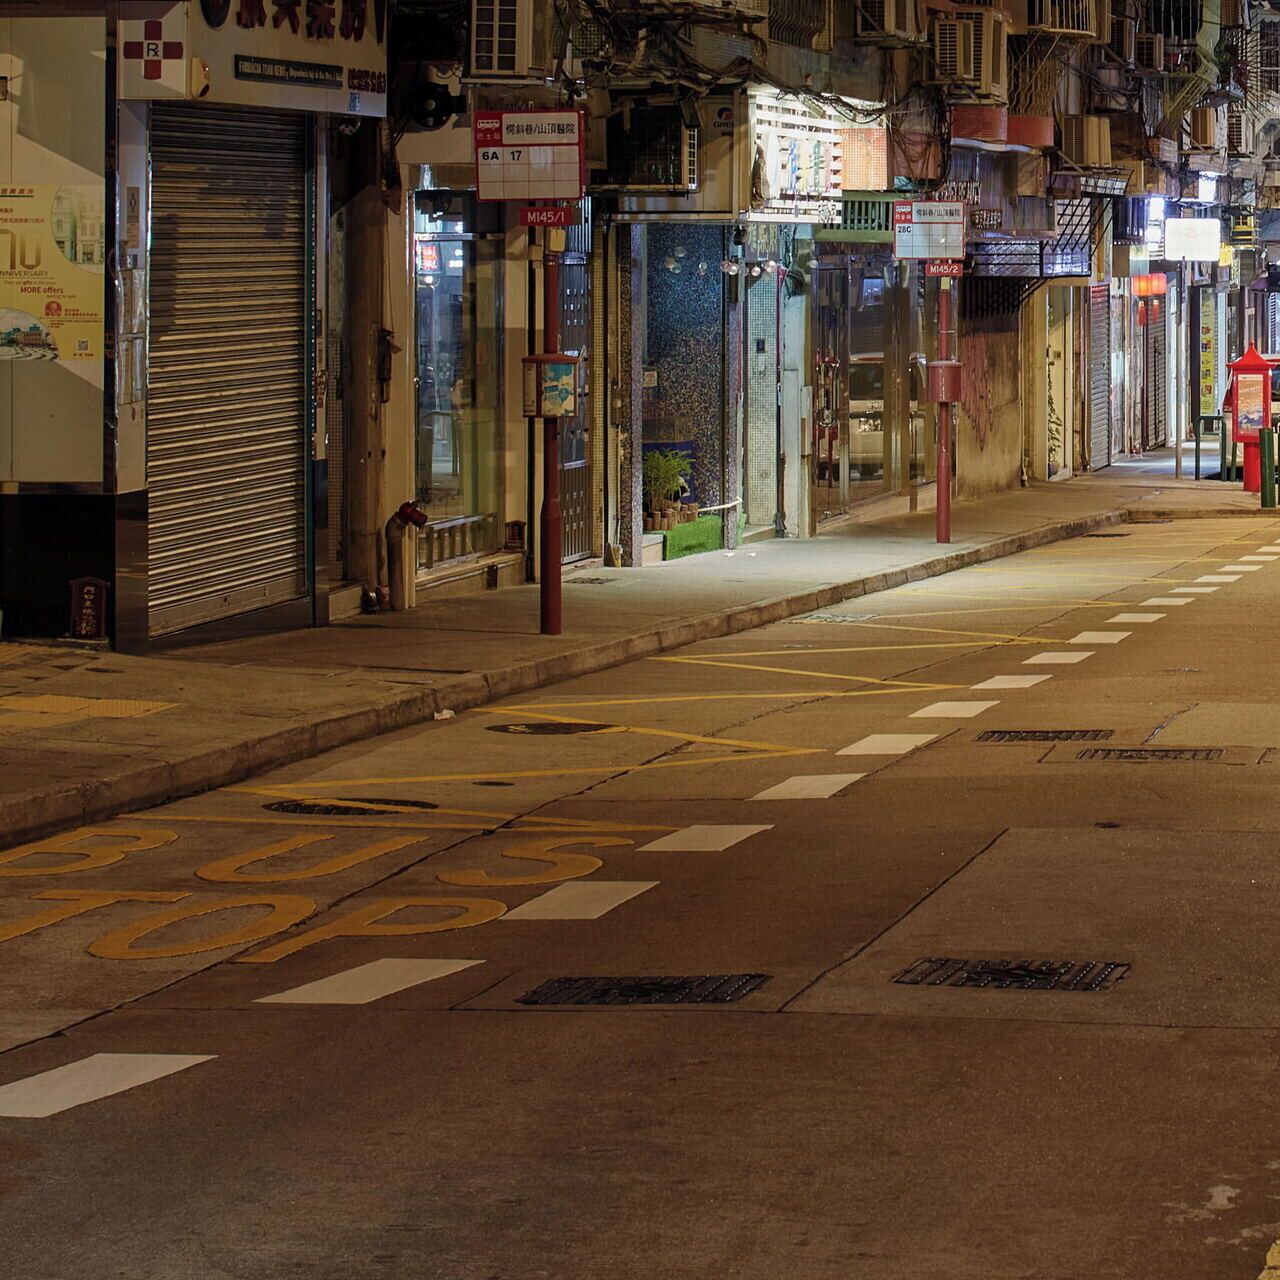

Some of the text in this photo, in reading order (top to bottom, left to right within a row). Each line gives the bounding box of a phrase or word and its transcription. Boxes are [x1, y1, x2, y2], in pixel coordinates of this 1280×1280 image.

[482, 150, 522, 161] 6A 17
[527, 211, 565, 223] M145/1
[897, 225, 912, 234] 28C
[930, 265, 959, 274] M145/2
[20, 286, 64, 294] MORE offers
